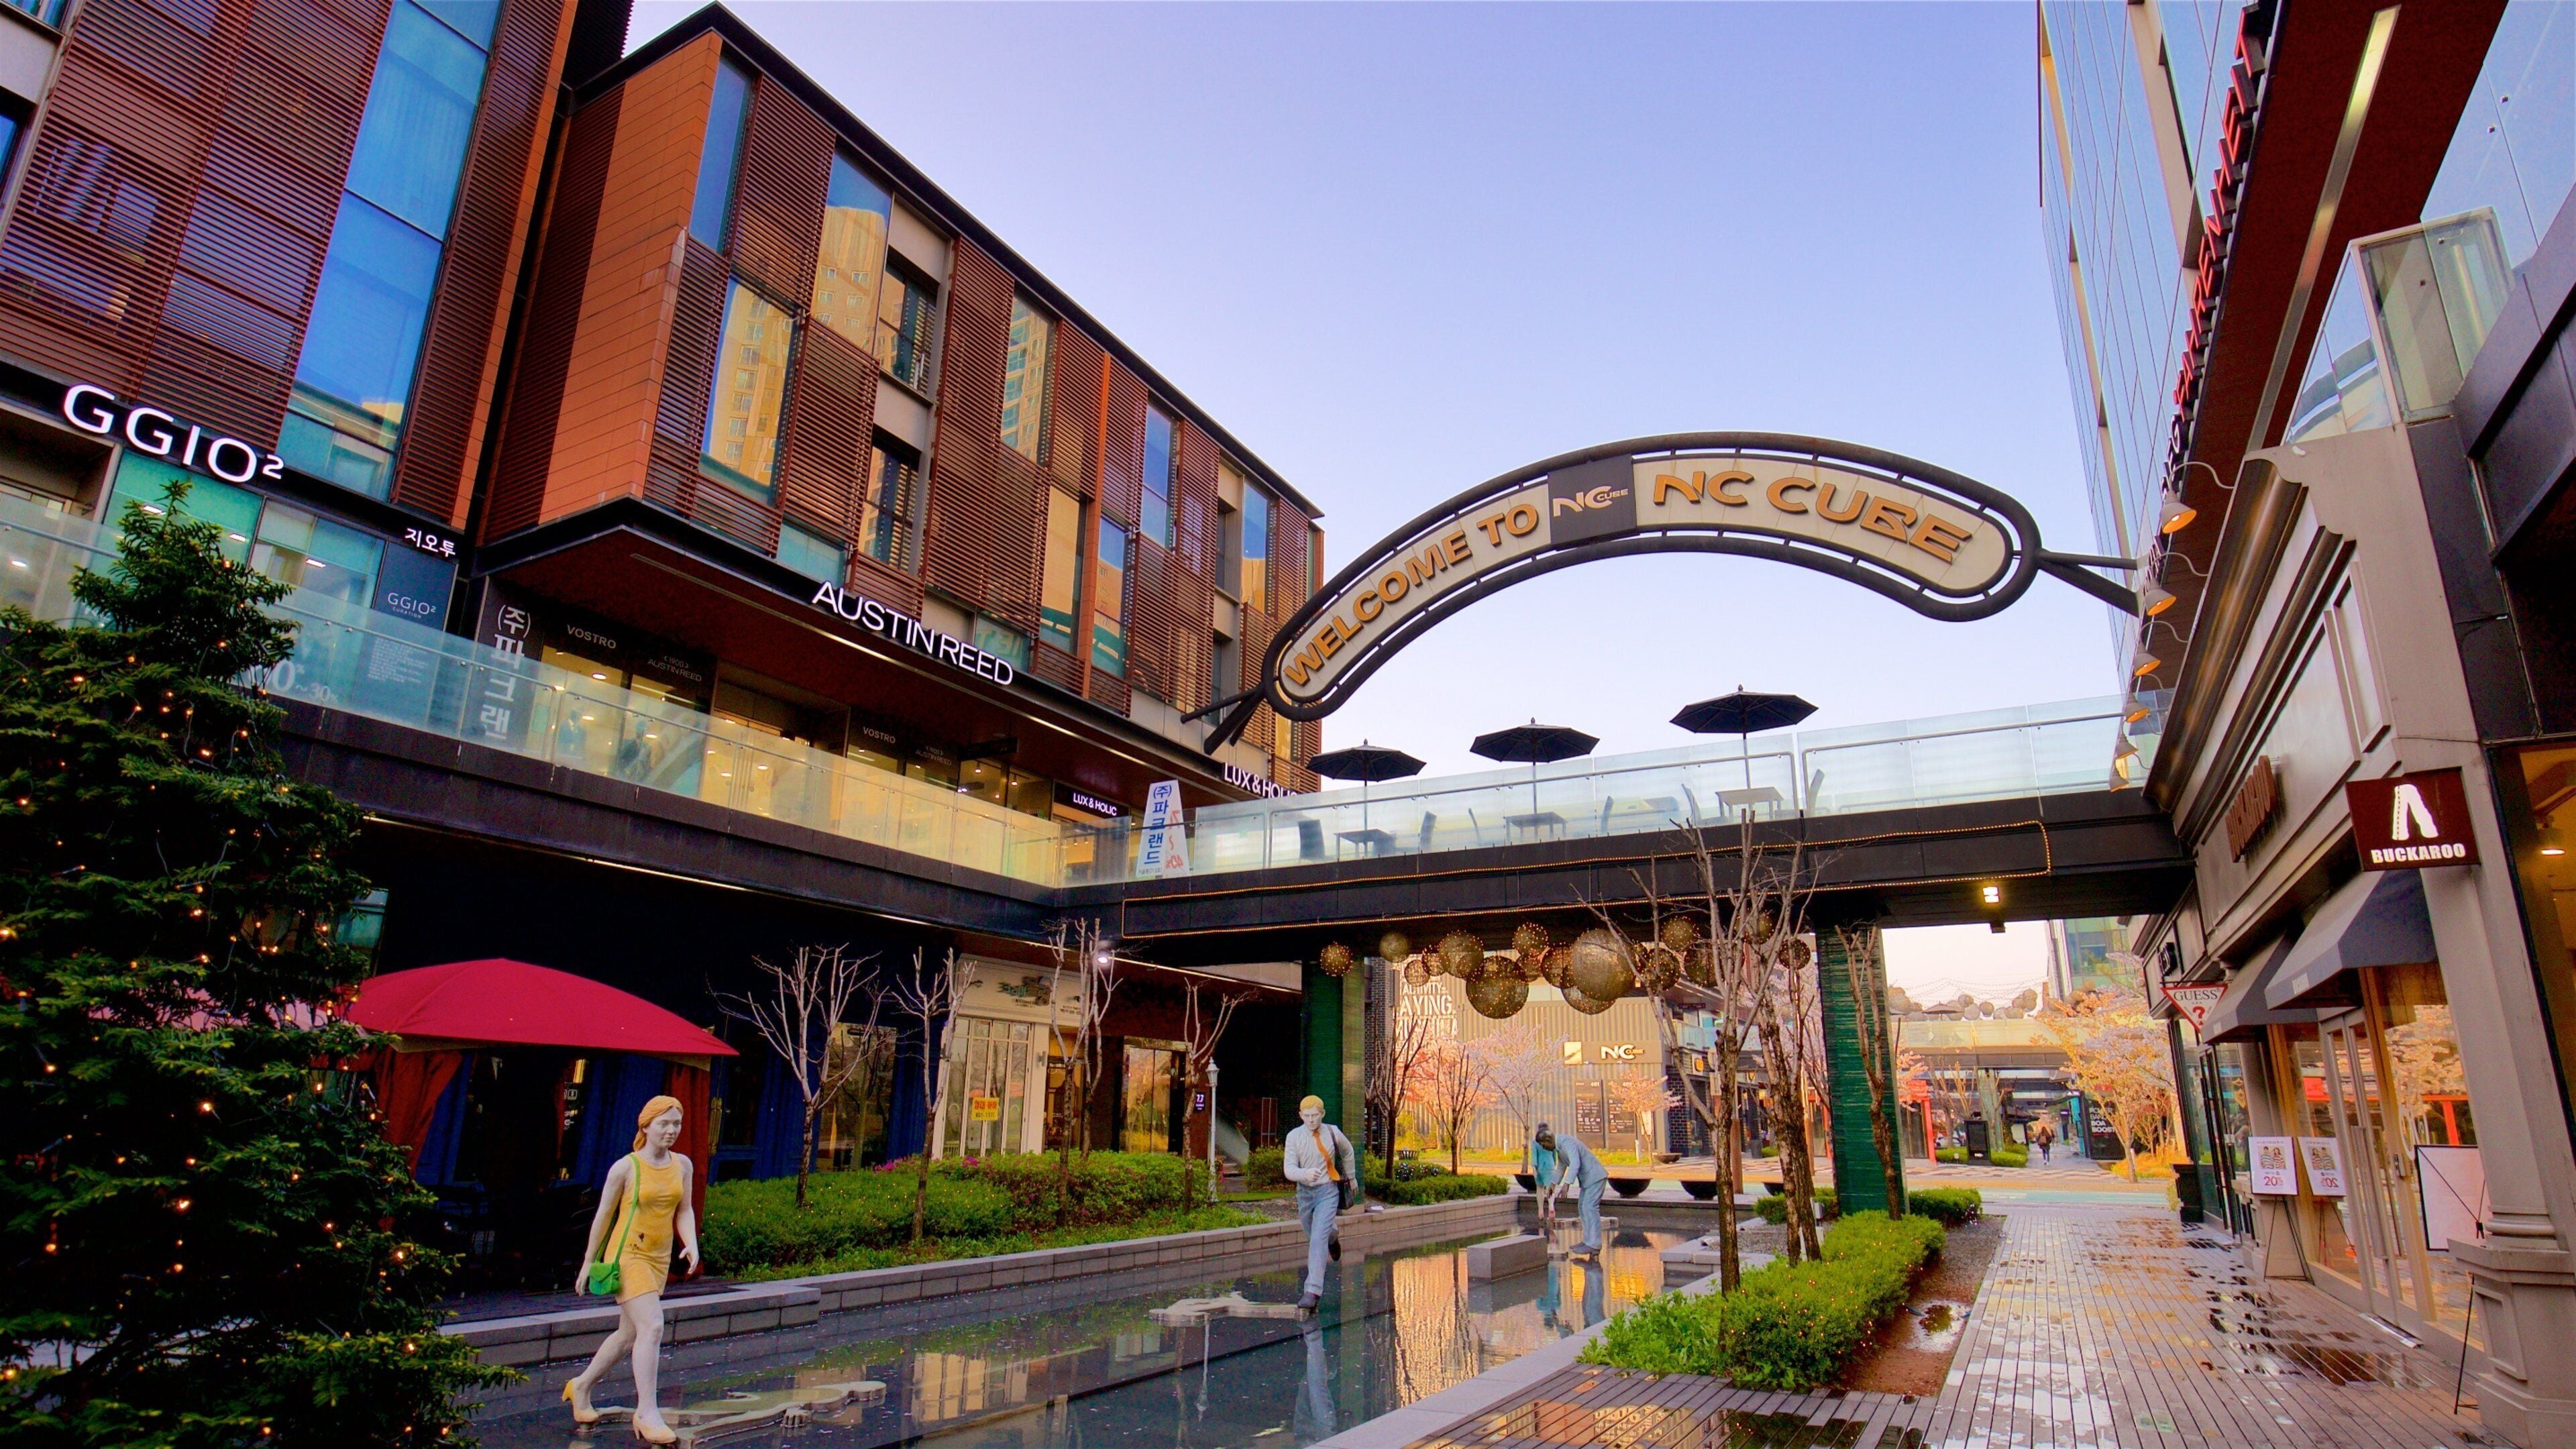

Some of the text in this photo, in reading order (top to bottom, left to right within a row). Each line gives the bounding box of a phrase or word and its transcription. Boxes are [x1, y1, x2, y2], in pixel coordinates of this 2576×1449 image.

[2173, 4, 2265, 421] FAHRENHEIT
[1552, 486, 1629, 517] NC CUBE
[1653, 470, 1972, 564] NC CUBE
[405, 527, 456, 557] 지오투
[1284, 504, 1539, 684] WELCOME TO
[566, 624, 616, 649] VOSTRO
[812, 581, 934, 654] AUSTIN
[939, 633, 1014, 686] REED
[647, 658, 702, 682] AUSTIN REED
[863, 727, 896, 744] VOSTRO
[1224, 761, 1251, 791] LUX
[1252, 773, 1261, 795] &
[1073, 792, 1117, 816] LUX & HOLIC
[1144, 784, 1172, 865] (주)파크랜드
[2370, 843, 2466, 864] BUCKAROO
[2173, 989, 2218, 1001] GUESS
[1601, 1044, 1635, 1059] NC
